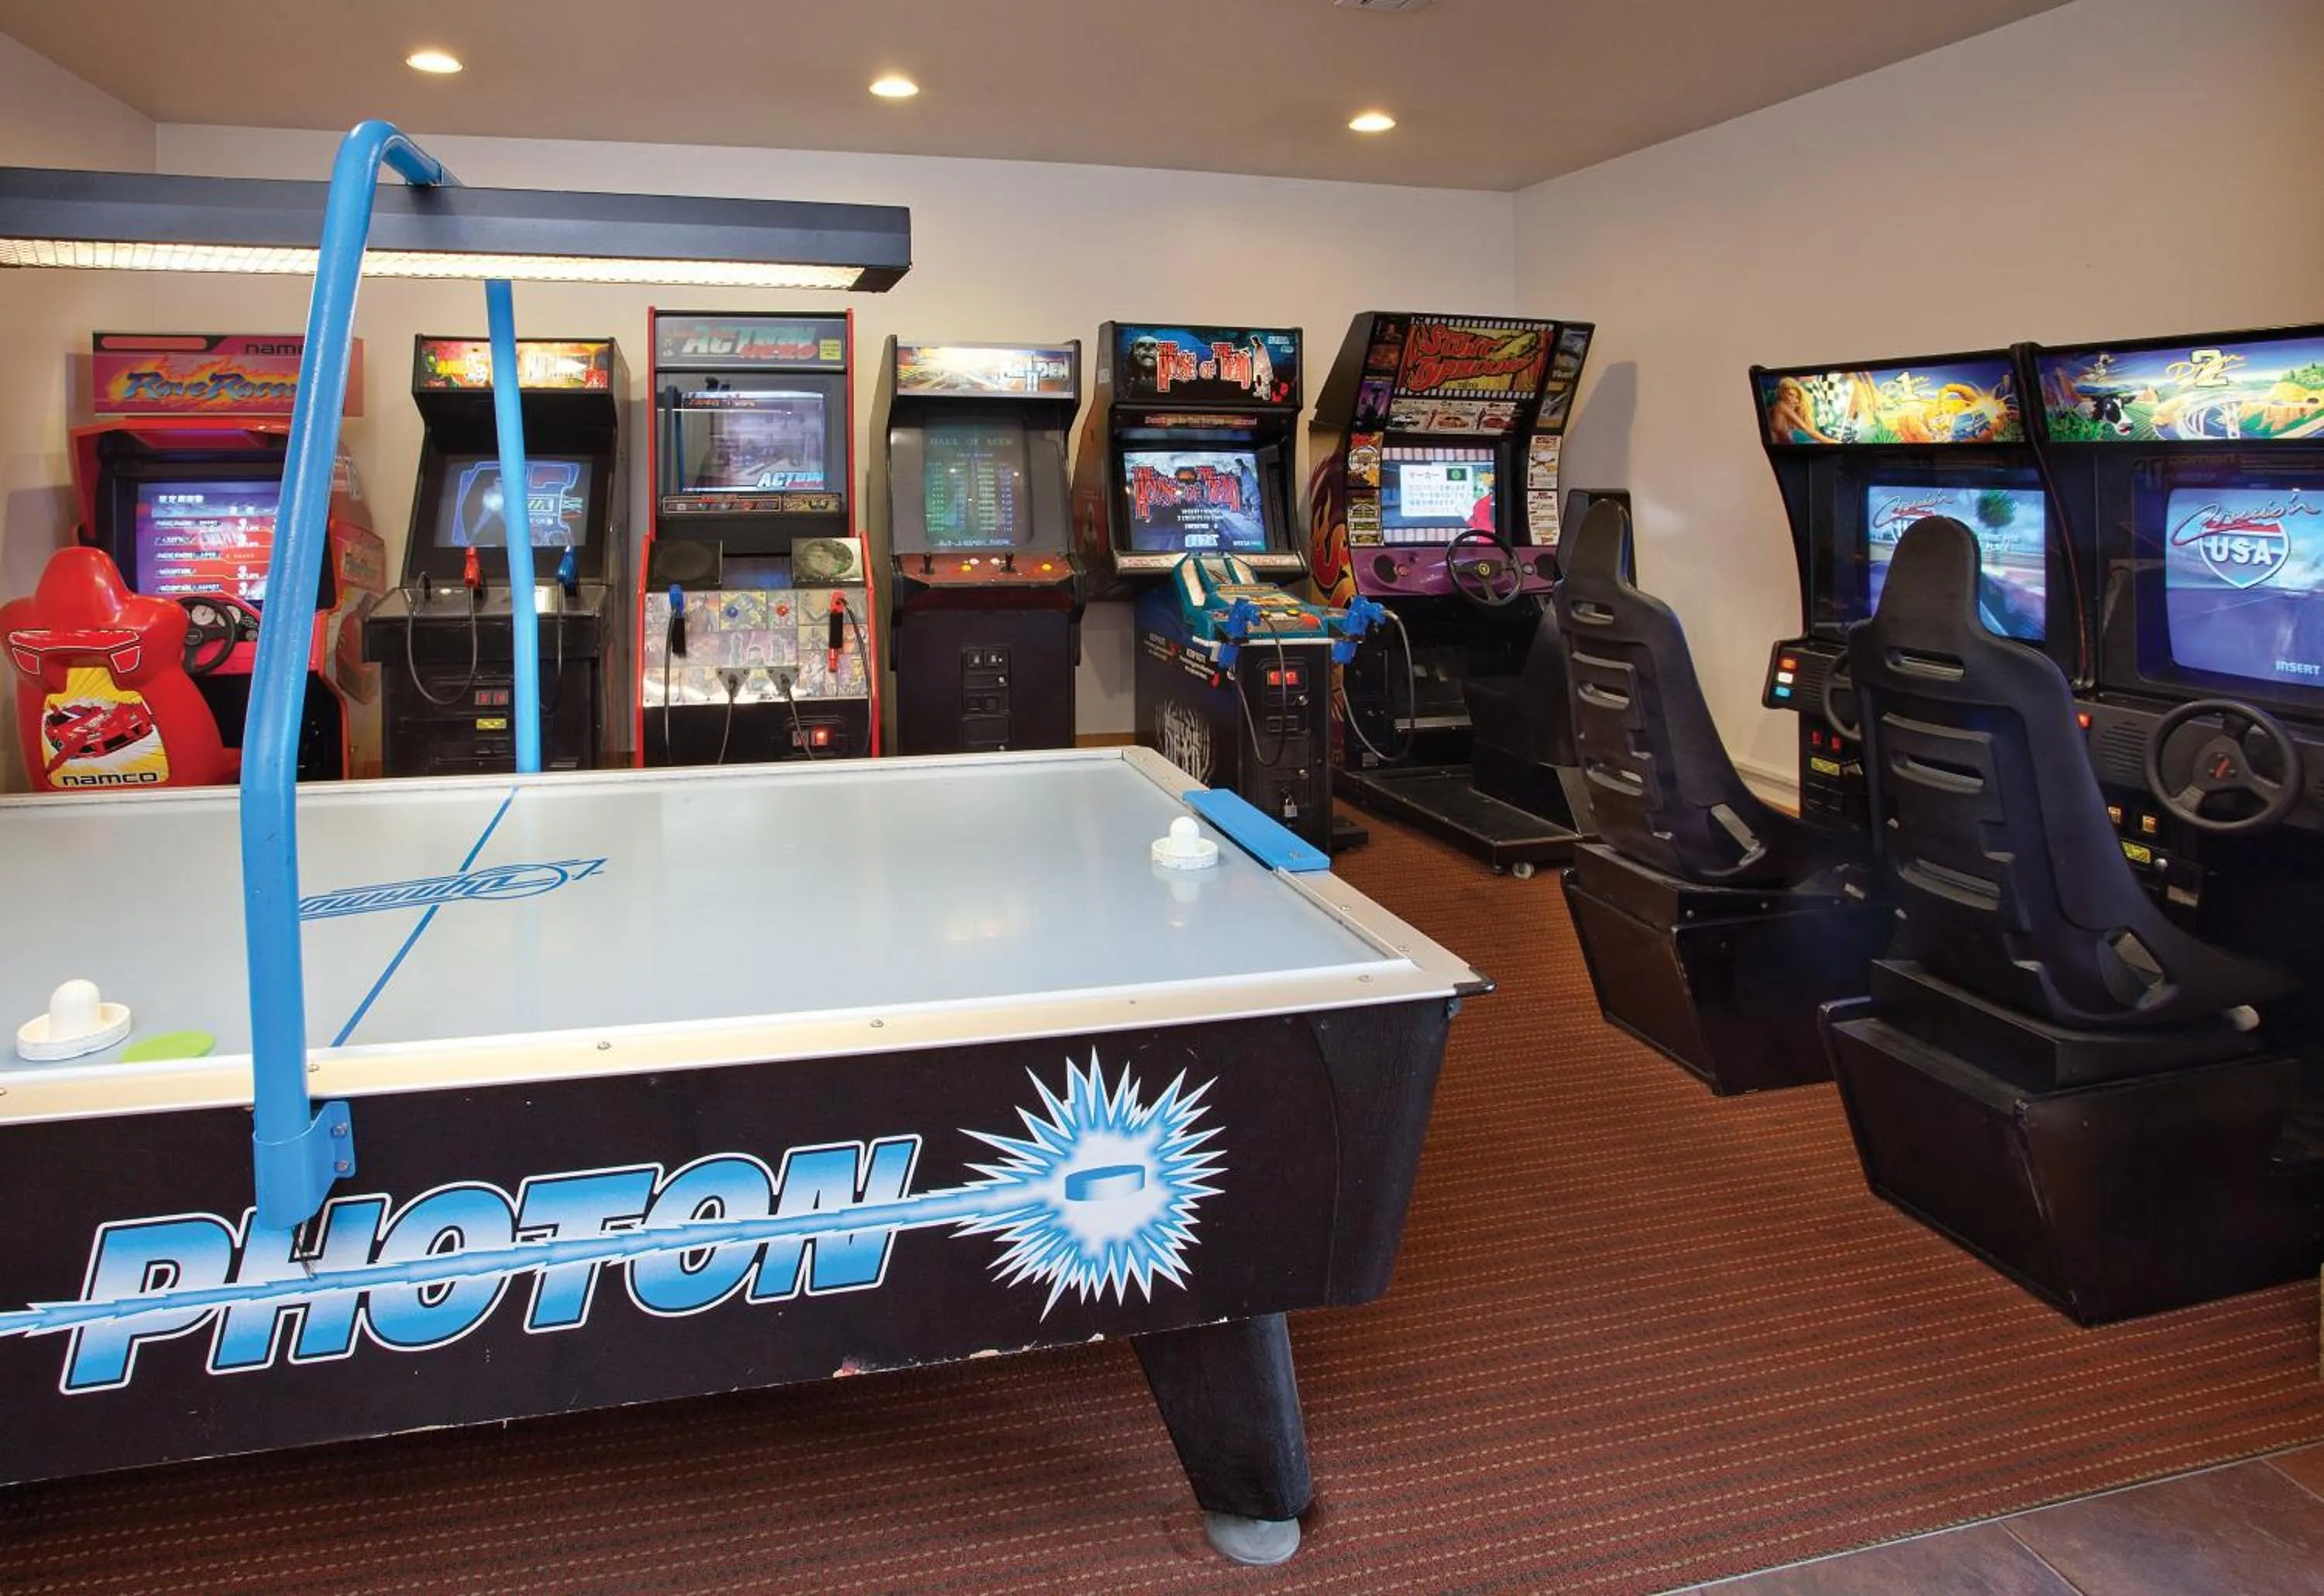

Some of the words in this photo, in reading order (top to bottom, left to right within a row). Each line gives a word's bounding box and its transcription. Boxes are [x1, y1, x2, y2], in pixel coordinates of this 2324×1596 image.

[246, 343, 304, 355] nam
[2170, 494, 2322, 546] Cruis'n
[2209, 537, 2273, 566] USA
[2275, 659, 2322, 676] INSERT
[61, 771, 159, 786] namco
[59, 1134, 922, 1395] PHOTON
